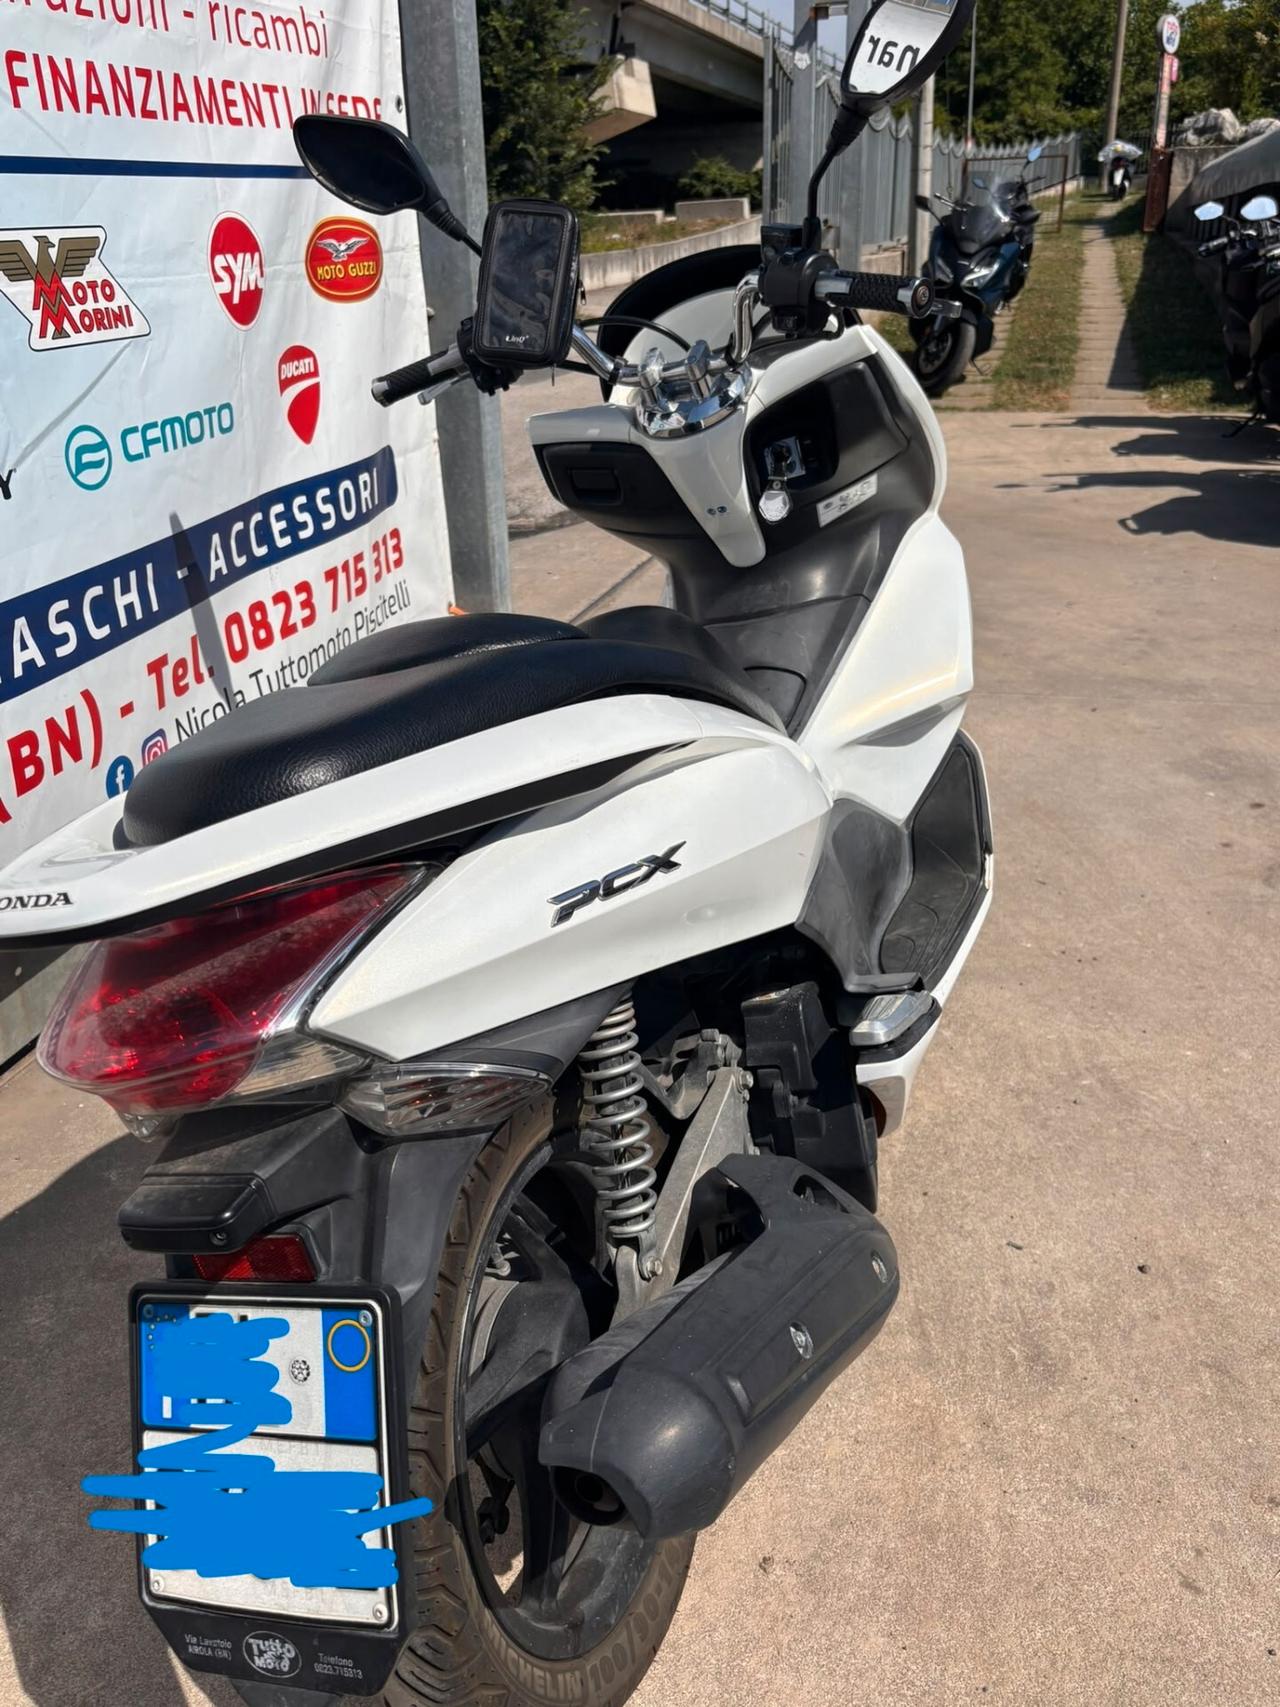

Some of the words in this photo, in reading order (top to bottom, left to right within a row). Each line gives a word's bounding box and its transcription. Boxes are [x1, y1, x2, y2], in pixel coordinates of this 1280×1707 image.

[208, 1, 329, 58] ricambi
[5, 49, 294, 129] FINANZIAMENTI
[32, 268, 115, 310] MOTO
[213, 252, 264, 304] SYM
[317, 265, 345, 280] MOTO
[348, 261, 377, 276] GUZZI
[39, 300, 134, 339] MORINI
[280, 357, 314, 380] DUCATI
[120, 402, 234, 463] CFMOTO
[0, 562, 159, 684] ASCHI
[209, 467, 379, 582] ACCESSORI
[249, 625, 352, 698] Tuttomoto
[354, 579, 411, 642] Piscitelli
[0, 688, 103, 824] BN)
[147, 633, 215, 711] Tel.
[224, 579, 317, 664] 0823
[323, 551, 367, 613] 715
[371, 527, 404, 584] 313
[547, 840, 687, 928] PCX
